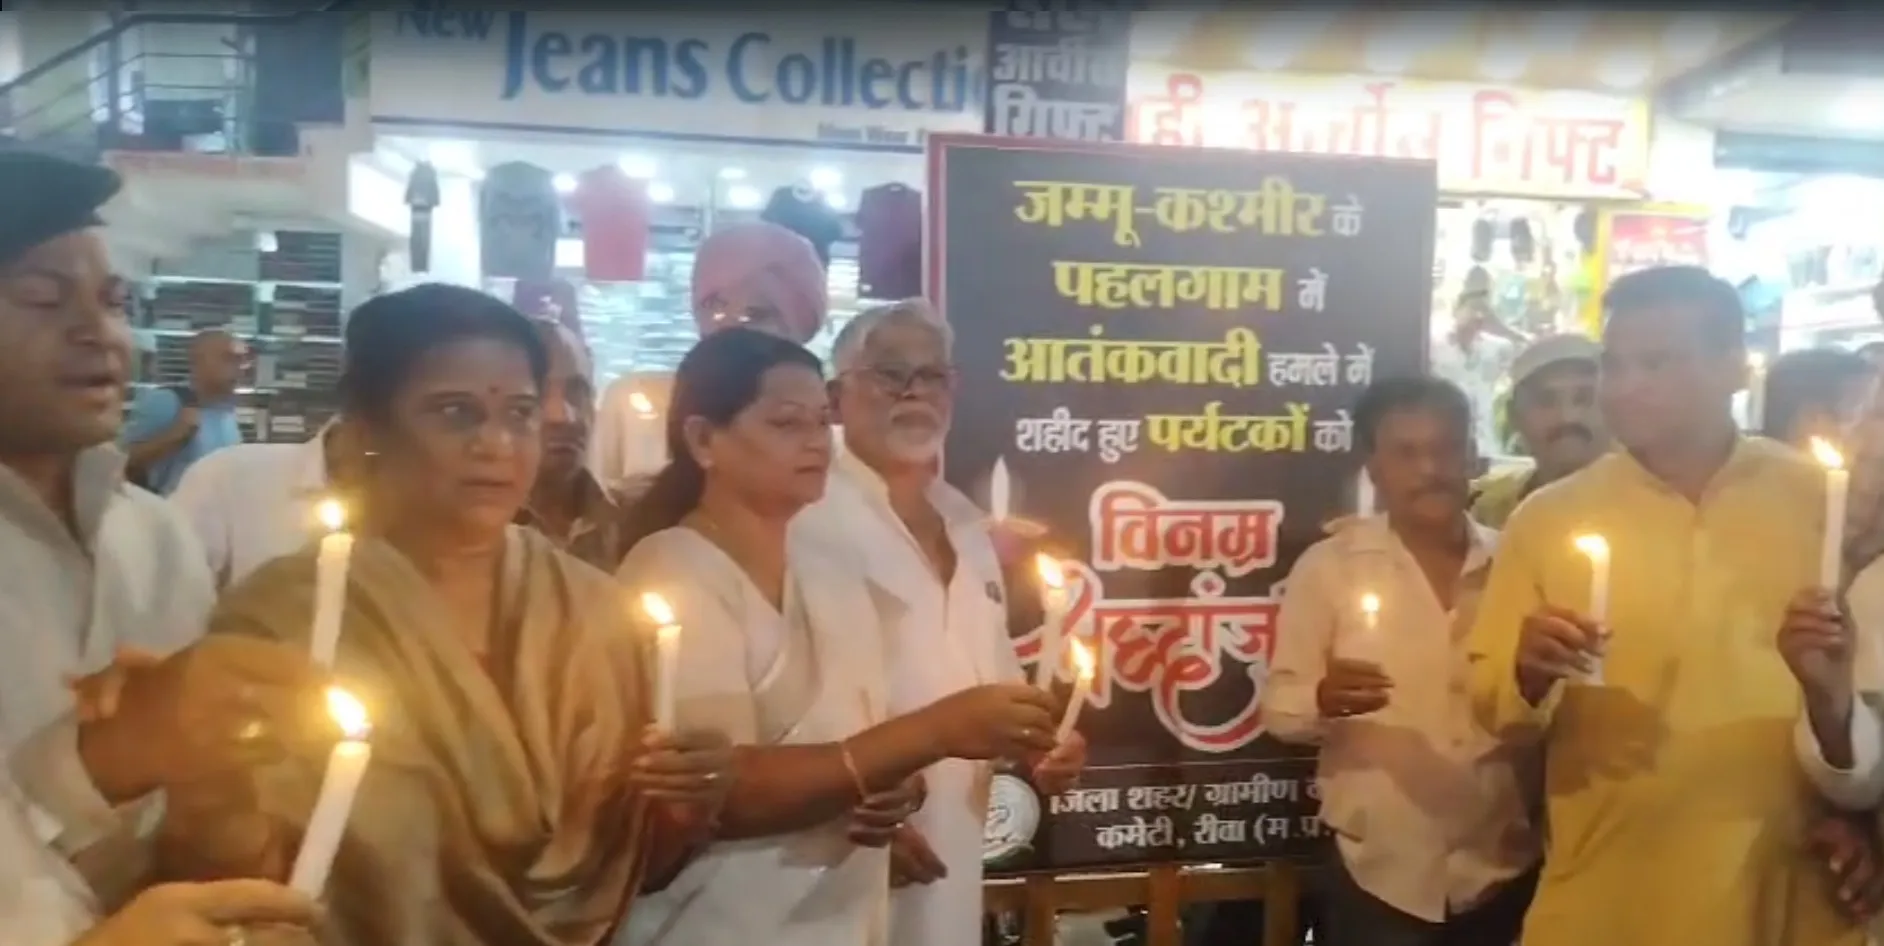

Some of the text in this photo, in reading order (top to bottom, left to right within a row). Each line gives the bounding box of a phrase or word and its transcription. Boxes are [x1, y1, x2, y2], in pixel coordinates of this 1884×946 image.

[393, 1, 497, 41] New
[502, 10, 986, 113] Jeans Collecti
[1013, 176, 1363, 248] जम्मू-कश्मीर के
[1051, 260, 1329, 313] पहलगाम में
[999, 324, 1375, 388] आतंकवादी हमले में
[1016, 402, 1355, 464] शहीद हुए पर्यटकों को
[1091, 481, 1283, 576] विनम्र
[1204, 773, 1299, 807] ग्रामीण
[1193, 813, 1247, 846] रीवा
